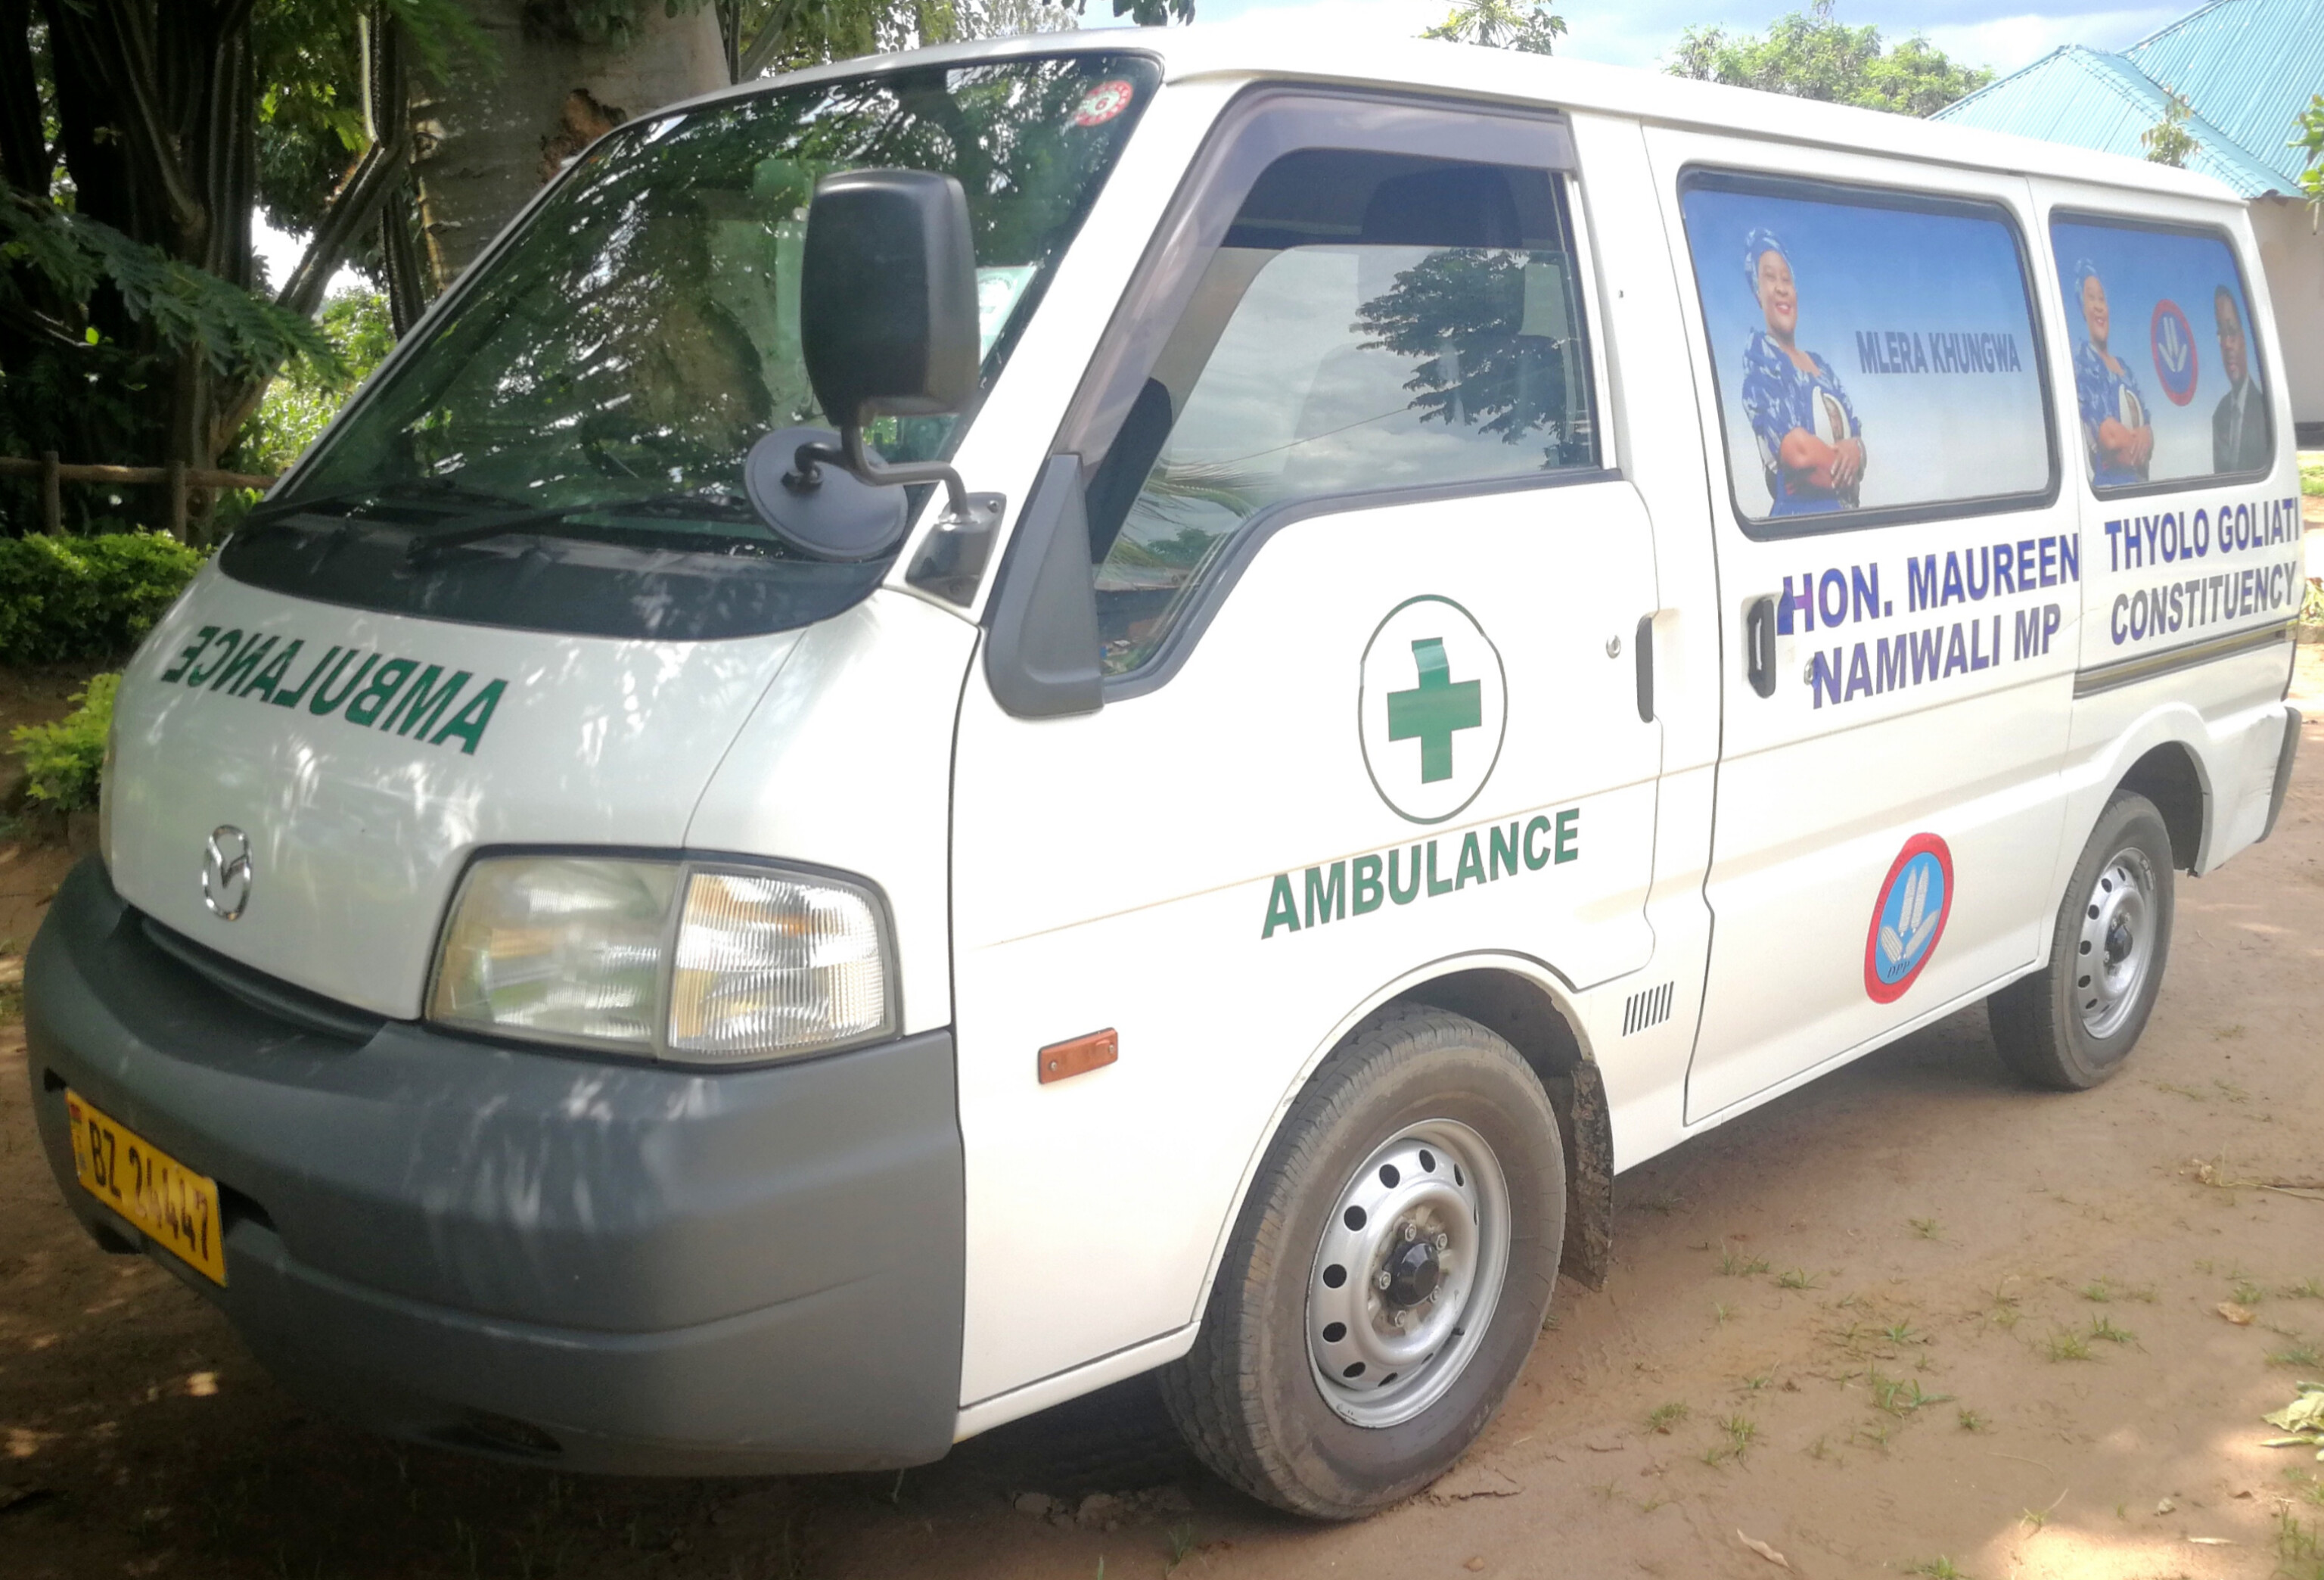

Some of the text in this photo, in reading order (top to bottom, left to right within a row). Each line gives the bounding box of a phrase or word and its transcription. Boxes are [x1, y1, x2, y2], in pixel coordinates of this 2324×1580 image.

[1855, 331, 2022, 374] MLERA KHUNGWA
[2105, 496, 2299, 573] THYOLO GOLIATI
[1776, 532, 2080, 636] HON. MAUREEN
[2111, 561, 2298, 646] CONSTITUENCY
[1813, 603, 2061, 710] NAMWALI MP
[1261, 807, 1580, 940] AMBULANCE
[1887, 960, 1910, 978] DPP
[89, 1118, 123, 1201] BZ
